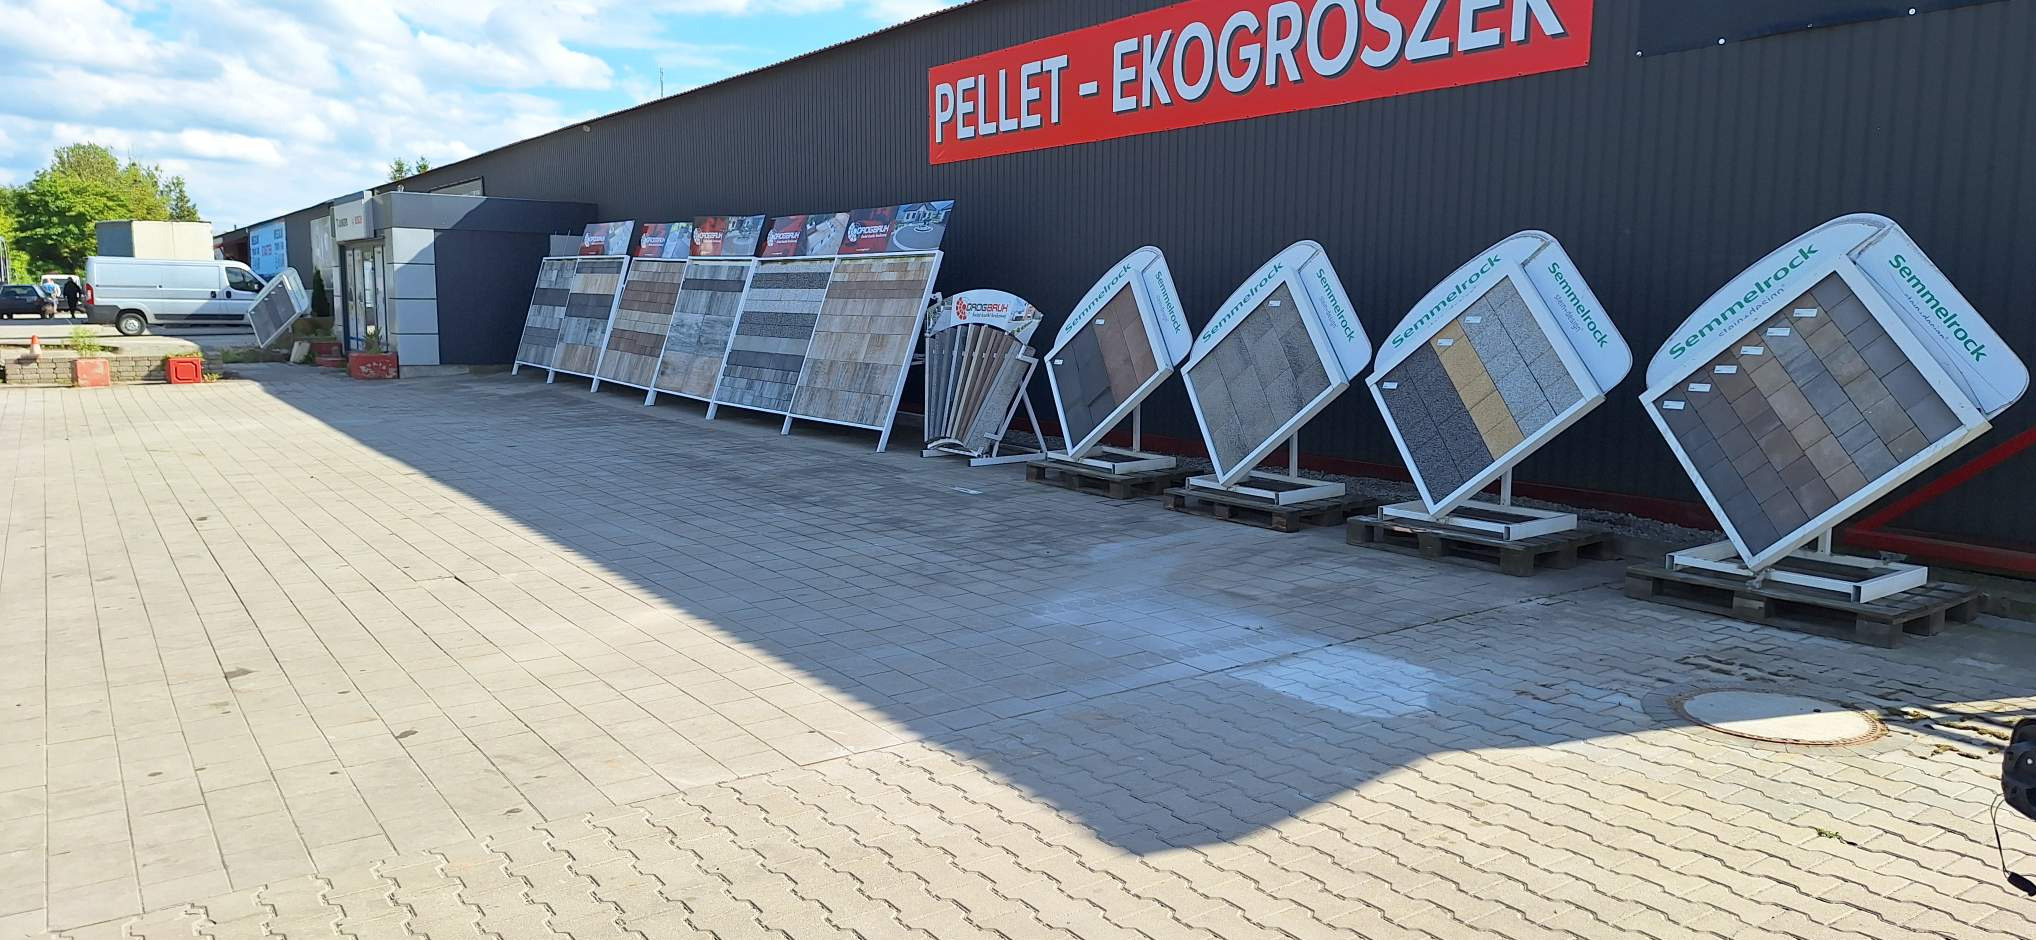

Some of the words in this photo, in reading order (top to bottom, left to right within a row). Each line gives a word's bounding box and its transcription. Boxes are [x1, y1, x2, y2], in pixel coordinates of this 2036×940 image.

[935, 54, 1068, 143] PELLET
[1078, 80, 1099, 97] -
[1064, 263, 1132, 334] Semmelrock
[1155, 271, 1182, 334] Semmelrock
[1202, 262, 1283, 343] Semmelrock
[1316, 268, 1355, 343] Semmelrock
[1391, 254, 1500, 348] Semmelrock
[1548, 262, 1608, 349] Semmelrock
[1669, 244, 1819, 359] Semmelrock
[1888, 254, 1987, 362] Semmelrock
